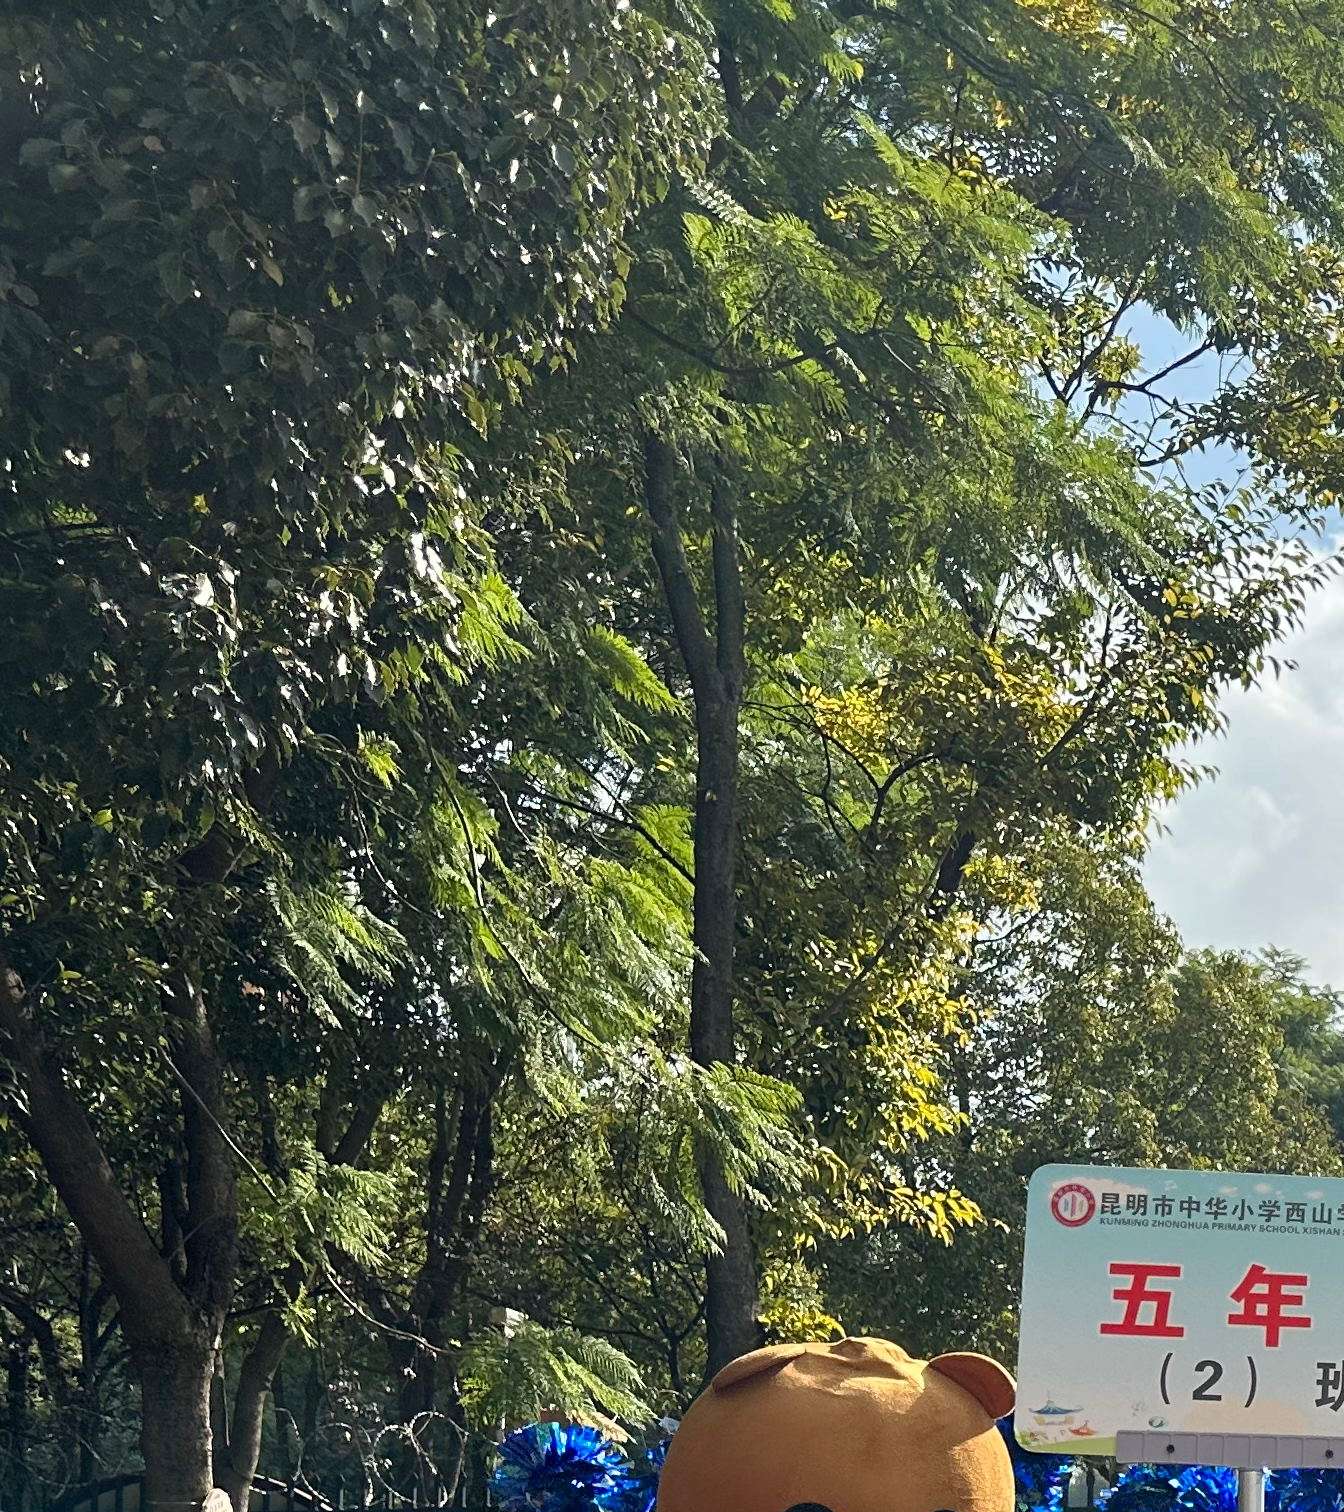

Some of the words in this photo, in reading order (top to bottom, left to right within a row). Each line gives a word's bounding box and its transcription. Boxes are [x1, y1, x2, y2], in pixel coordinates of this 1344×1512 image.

[1100, 1217, 1149, 1227] KUNMING
[1151, 1219, 1209, 1230] ZHONGHUA
[1211, 1222, 1257, 1233] PRIMARY
[1259, 1225, 1299, 1235] SCHOOL
[1302, 1227, 1340, 1237] XISHAN
